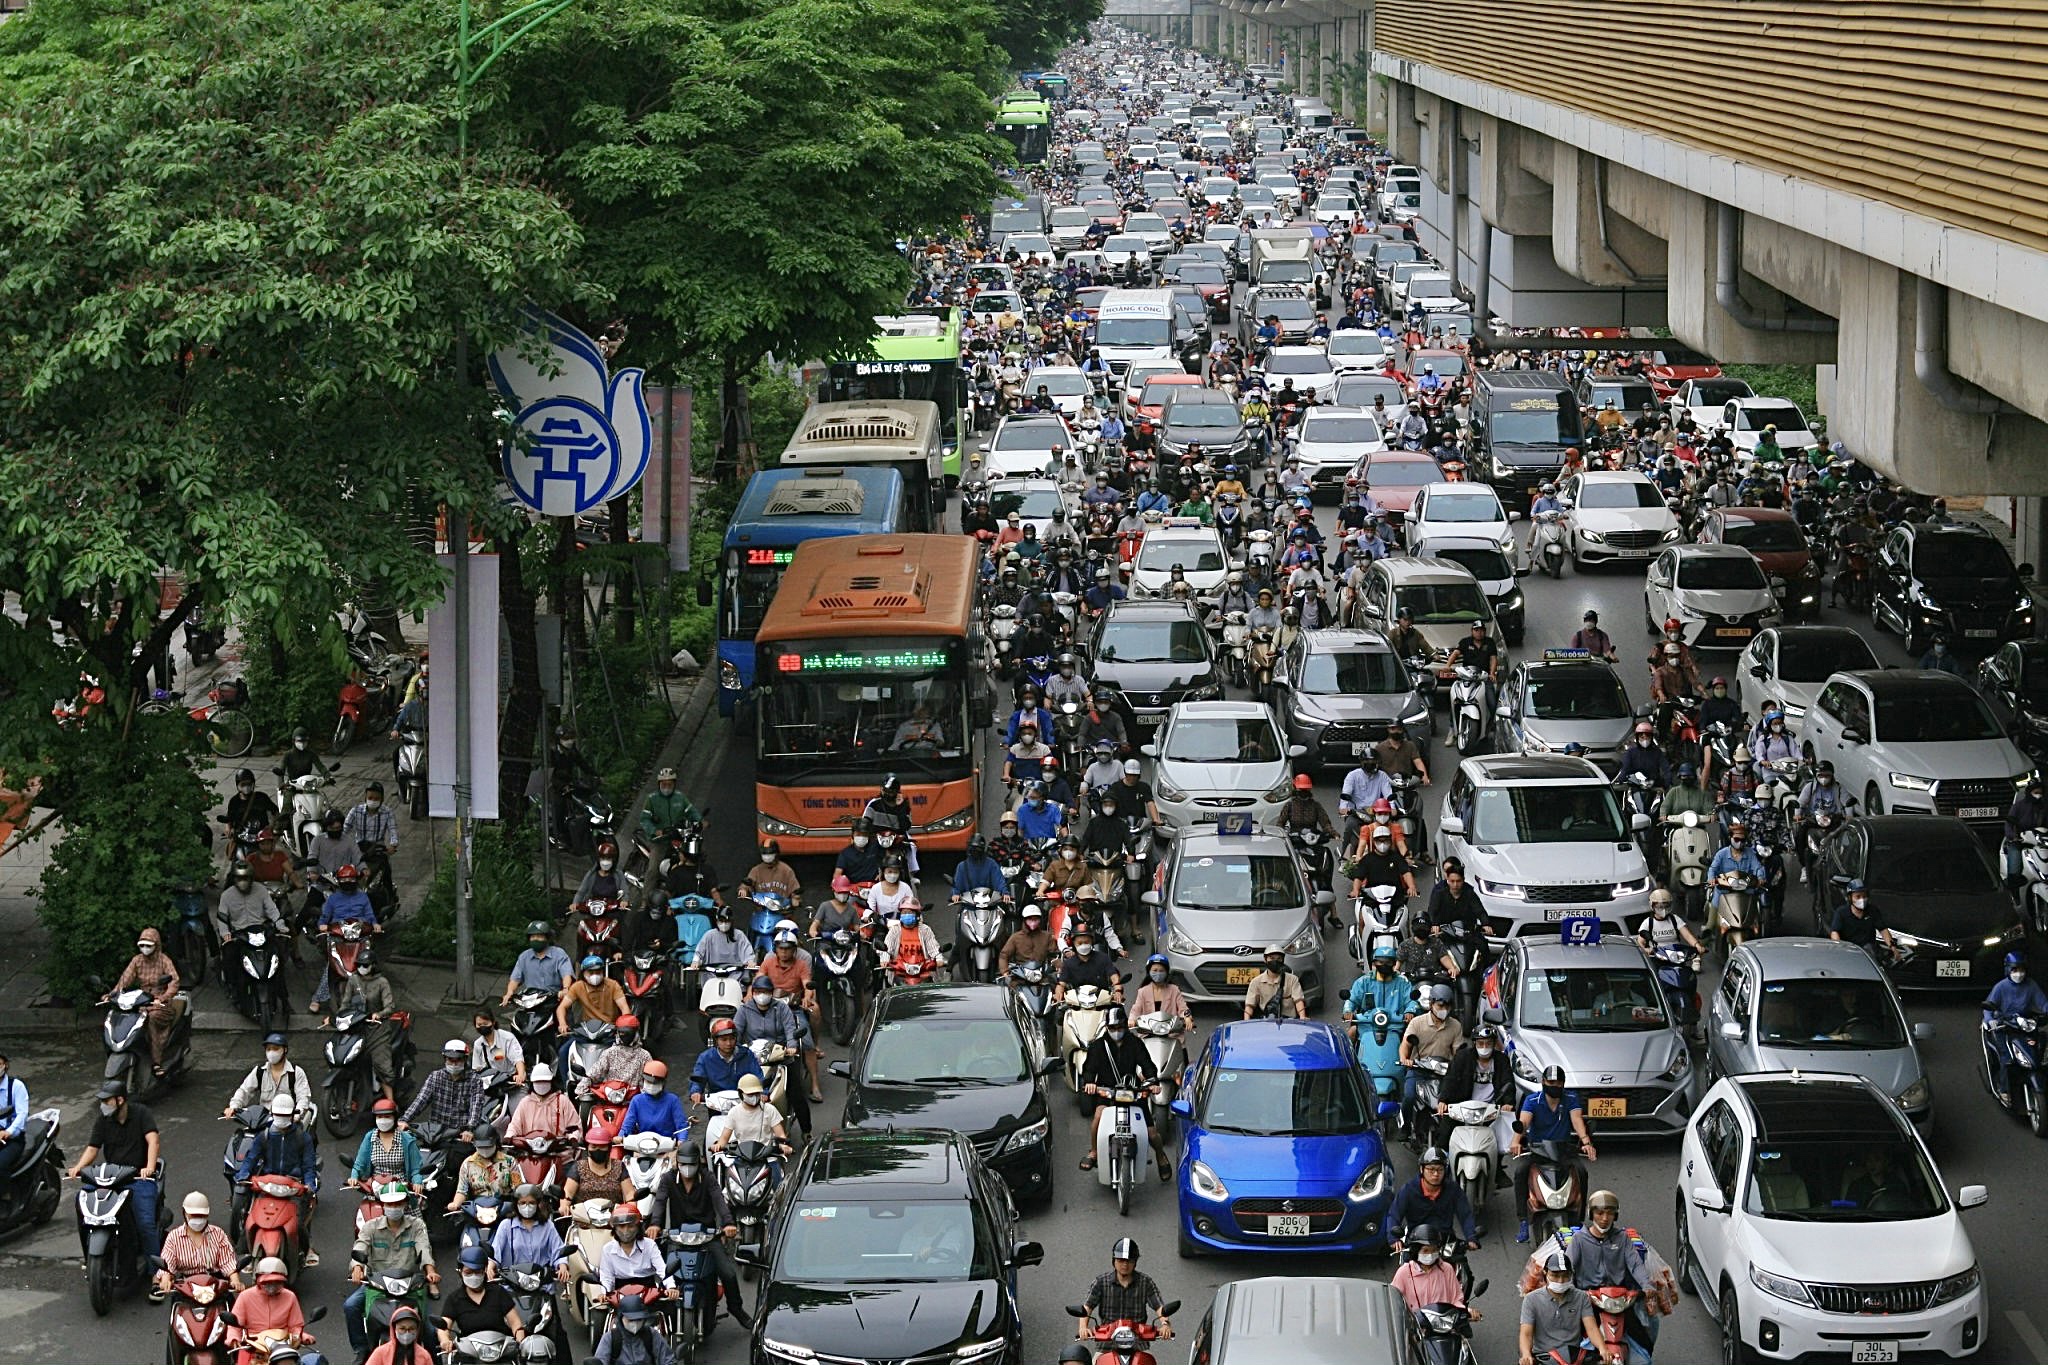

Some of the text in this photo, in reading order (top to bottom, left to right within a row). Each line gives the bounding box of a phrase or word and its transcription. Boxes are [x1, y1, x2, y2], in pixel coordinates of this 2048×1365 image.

[748, 549, 774, 564] 21A
[803, 654, 823, 669] HÀ
[825, 653, 863, 668] ĐÔNG
[1570, 920, 1592, 941] G7
[1599, 1099, 1616, 1108] 29E
[1280, 1216, 1298, 1226] 30G
[1272, 1226, 1305, 1236] 764.74
[1865, 1342, 1886, 1352] 30L
[1856, 1352, 1893, 1362] 025.23
